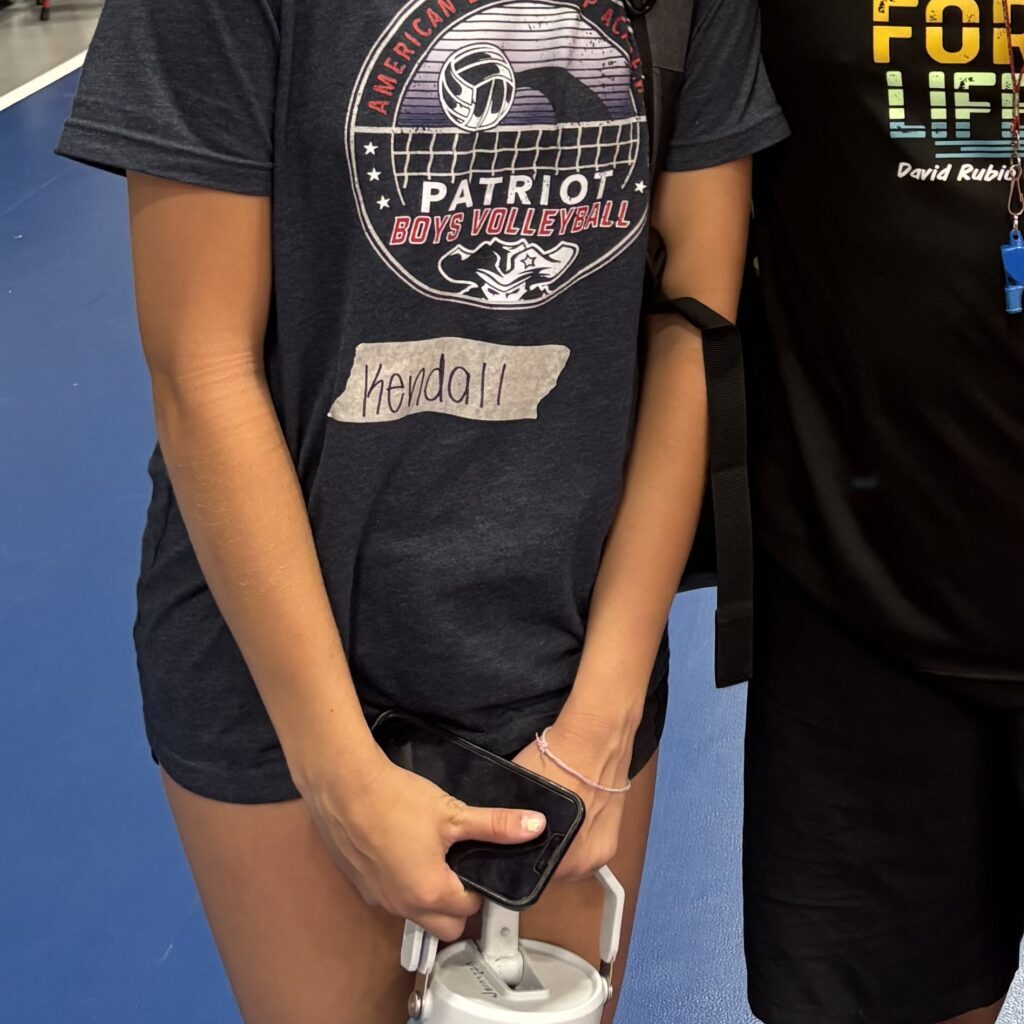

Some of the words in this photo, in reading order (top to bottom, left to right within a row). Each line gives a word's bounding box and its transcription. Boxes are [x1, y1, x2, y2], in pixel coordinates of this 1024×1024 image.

[420, 170, 614, 214] PATRIOT
[897, 160, 951, 182] David
[389, 212, 466, 246] BOYS
[470, 199, 632, 238] VOLLEYBALL
